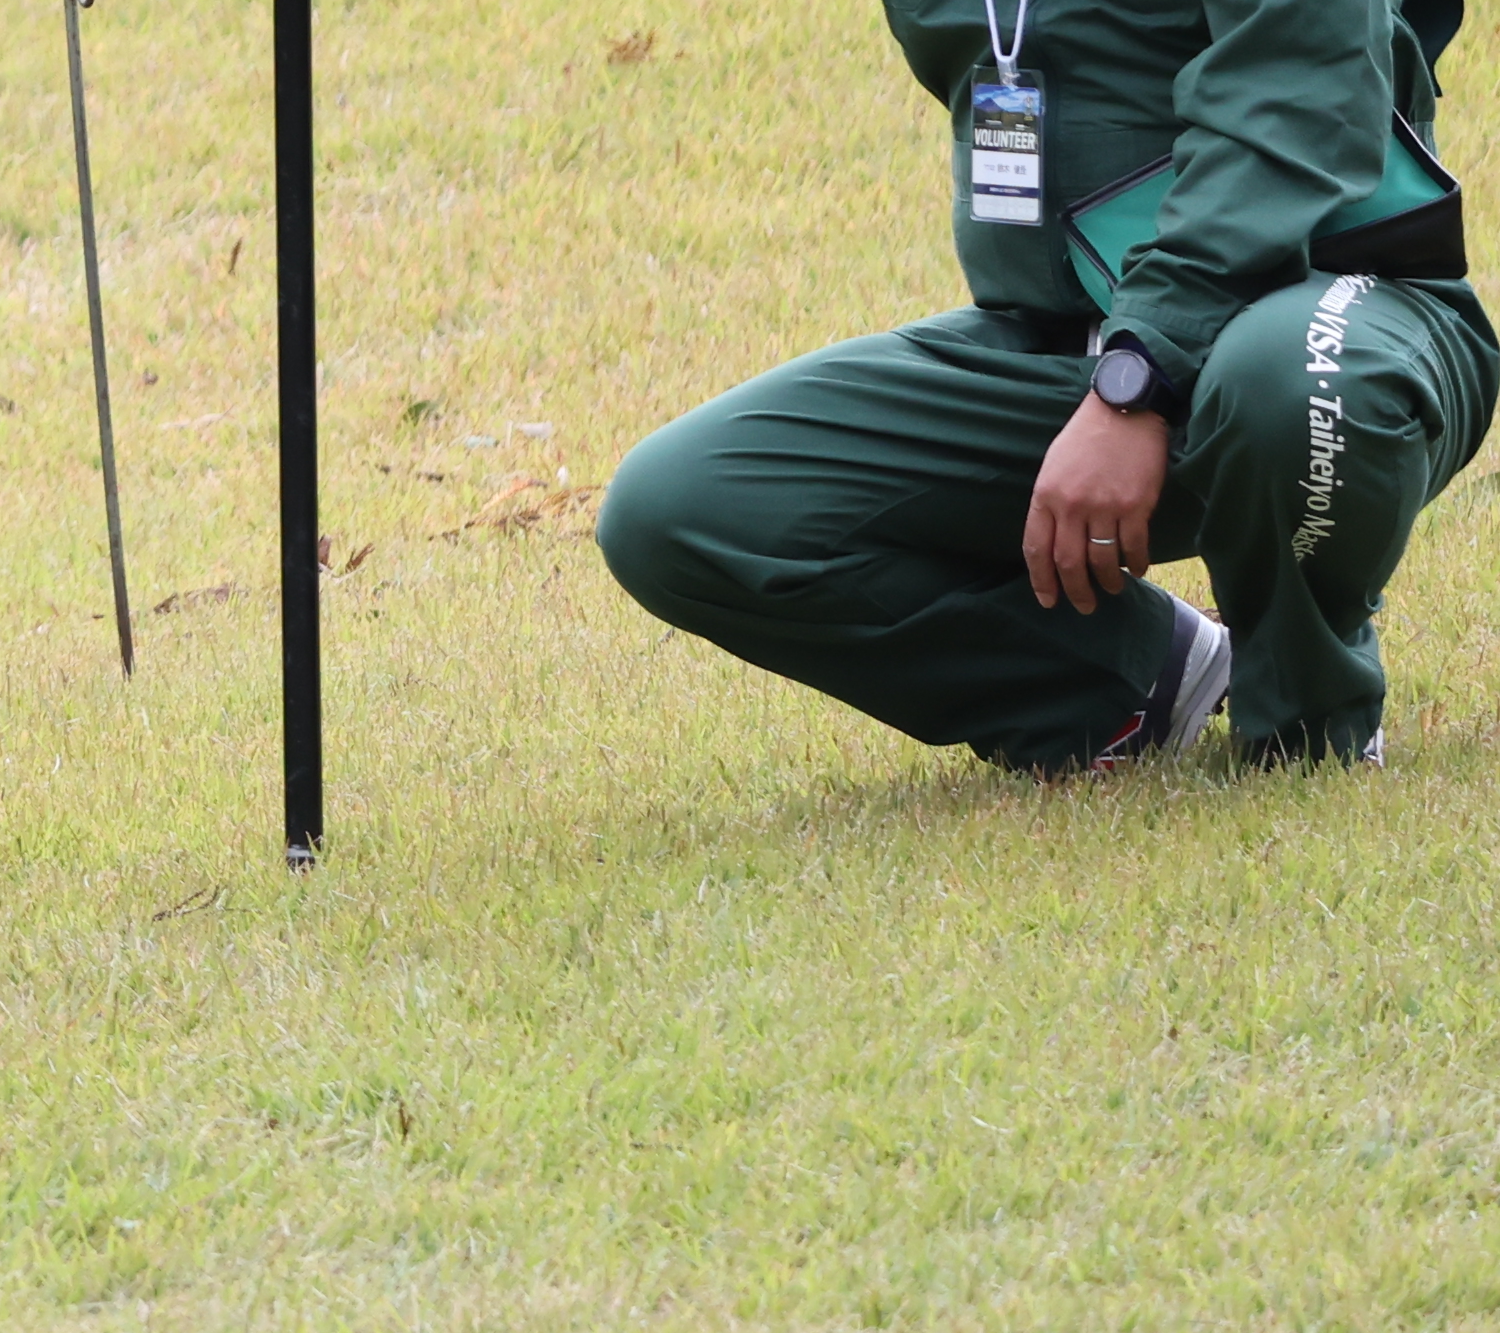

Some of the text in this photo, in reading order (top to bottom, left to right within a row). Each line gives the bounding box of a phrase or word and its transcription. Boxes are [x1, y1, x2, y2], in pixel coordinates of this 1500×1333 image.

[974, 127, 1037, 151] VOLUNTEER
[1306, 311, 1350, 373] VISA
[1298, 395, 1346, 512] Taiheiyo
